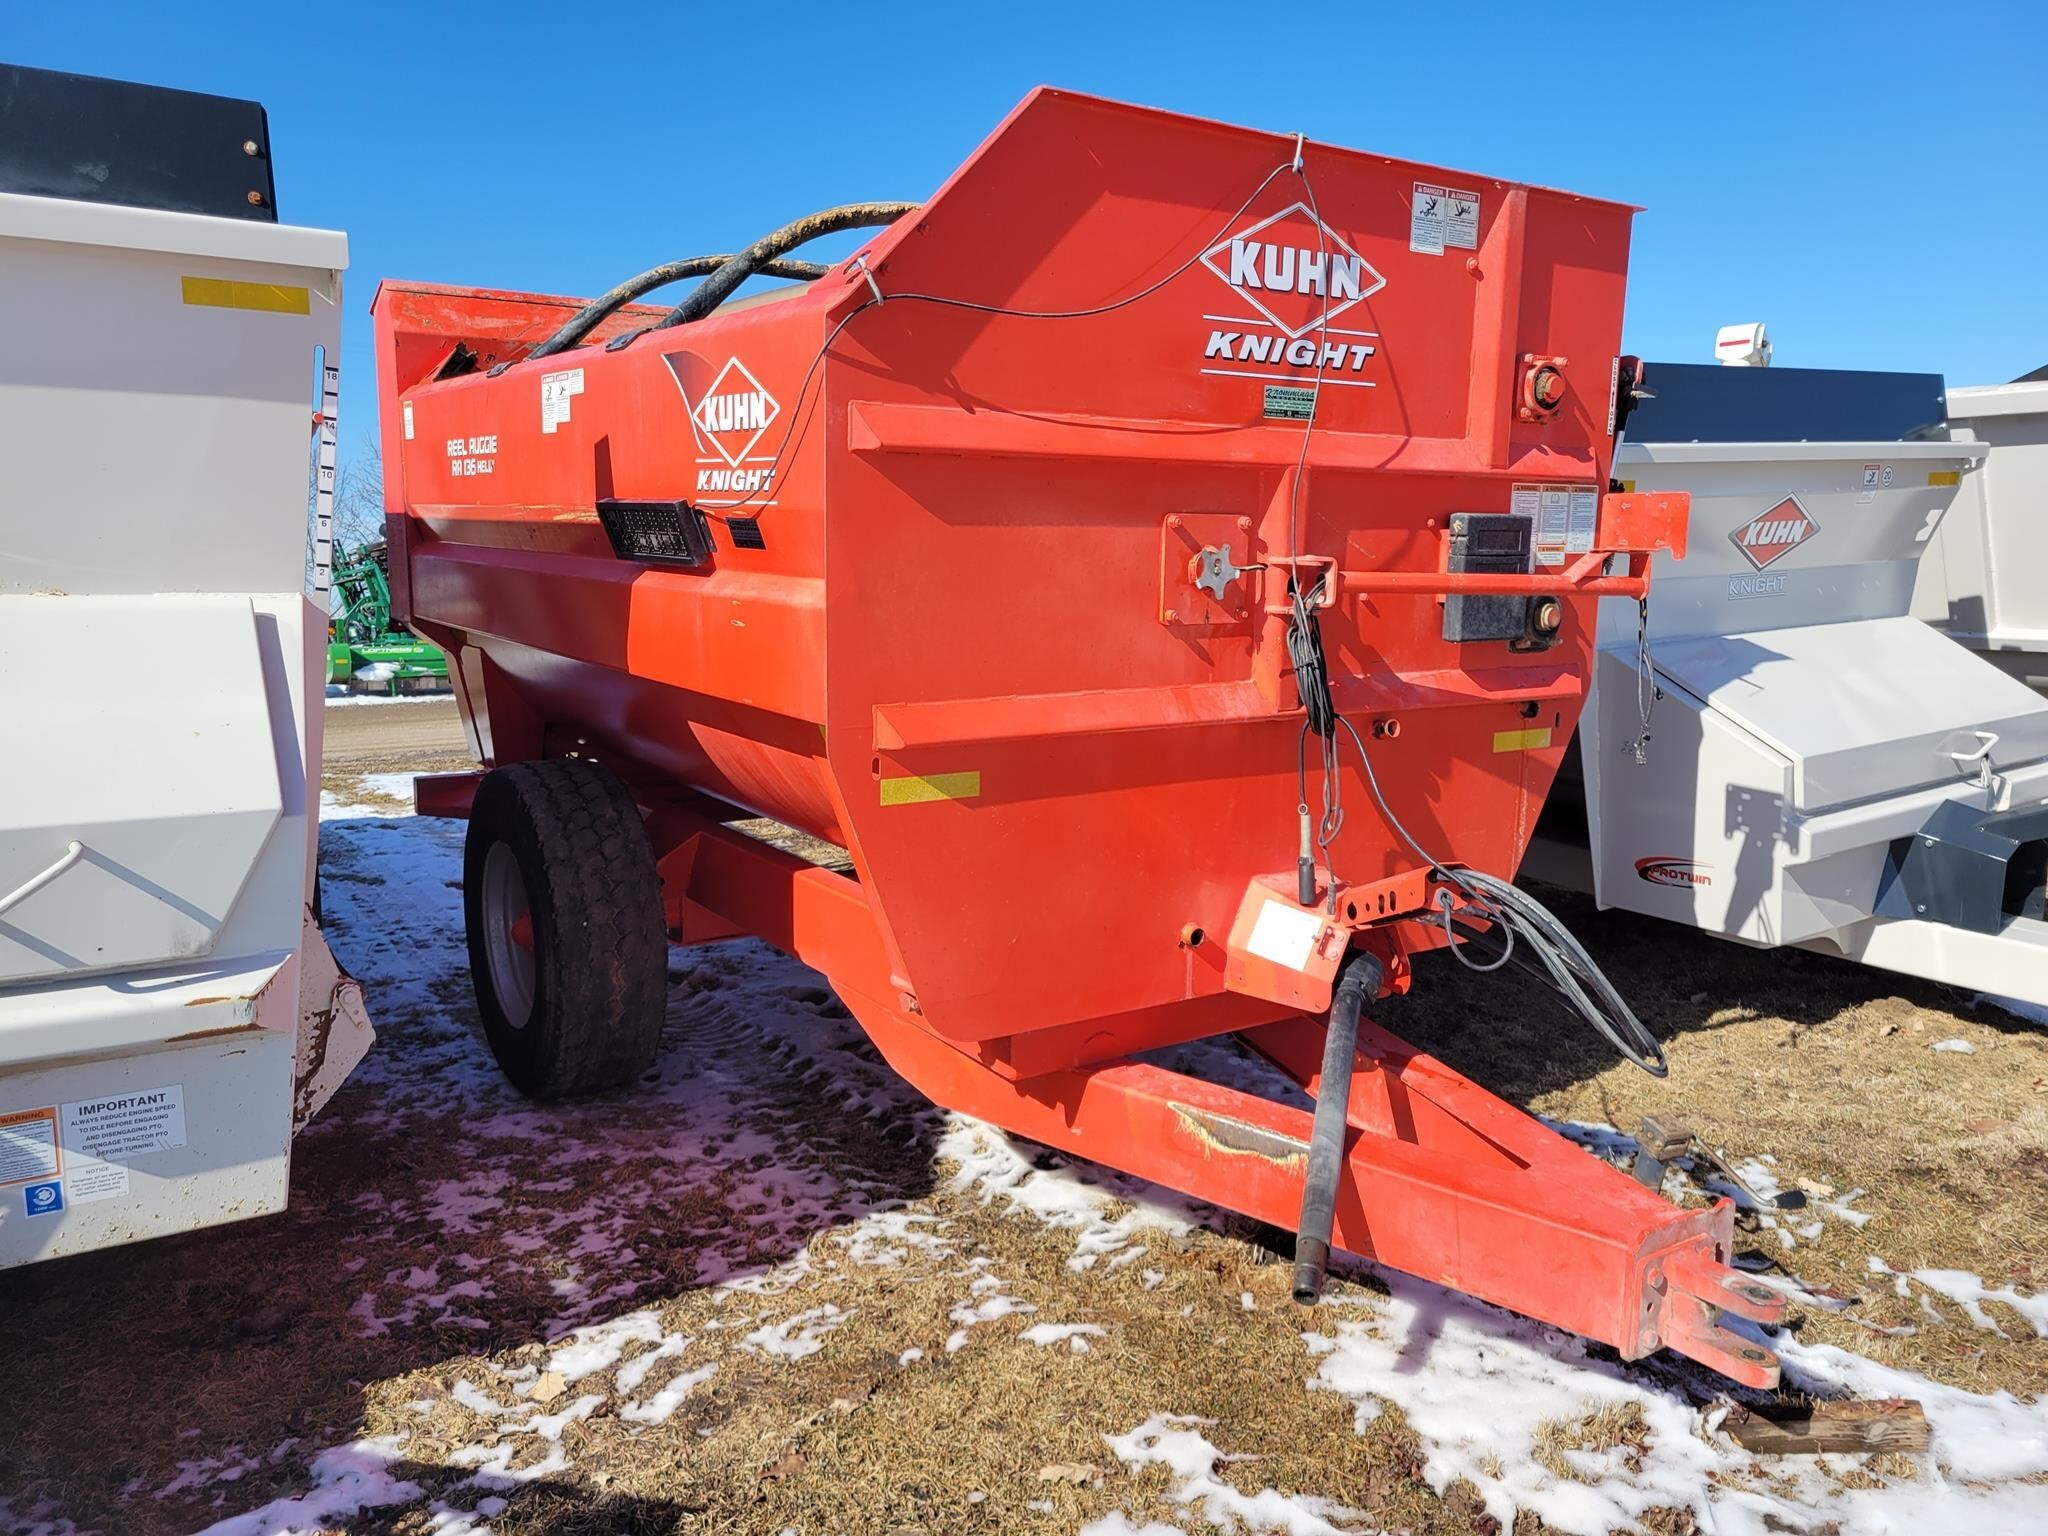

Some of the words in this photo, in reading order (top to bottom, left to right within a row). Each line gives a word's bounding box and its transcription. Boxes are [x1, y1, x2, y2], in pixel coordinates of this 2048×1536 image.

[1423, 187, 1444, 196] DANGER
[1456, 192, 1476, 202] DANGER
[1230, 239, 1361, 300] KUHN
[1204, 330, 1377, 372] KNIGHT
[327, 372, 338, 381] 18
[705, 391, 766, 432] KUHN
[325, 421, 335, 430] 14
[447, 439, 468, 457] REEL
[469, 435, 497, 455] AUGGIE
[322, 471, 333, 479] 10
[452, 459, 463, 477] RA
[463, 458, 476, 476] 136
[696, 469, 777, 492] KNIGHT
[321, 519, 327, 527] 6
[1742, 519, 1808, 546] KUHN
[319, 568, 325, 576] 2
[1729, 575, 1786, 595] KNIGHT
[1651, 866, 1712, 886] PROTWIN
[79, 1093, 166, 1116] IMPORTANT
[0, 1111, 45, 1124] WARNING
[71, 1117, 99, 1126] ALWAYS
[100, 1112, 127, 1121] REDUCE
[129, 1109, 153, 1117] ENGINE
[155, 1104, 176, 1112] SPEED
[106, 1120, 133, 1128] BEFORE
[134, 1114, 169, 1124] ENGAGING
[82, 1140, 121, 1151] DISENGAGE
[123, 1133, 154, 1143] TRACTOR
[86, 1134, 100, 1142] AND
[101, 1126, 148, 1139] DISENGAGING
[96, 1147, 122, 1157] BEFORE
[86, 1166, 109, 1174] NOTICE
